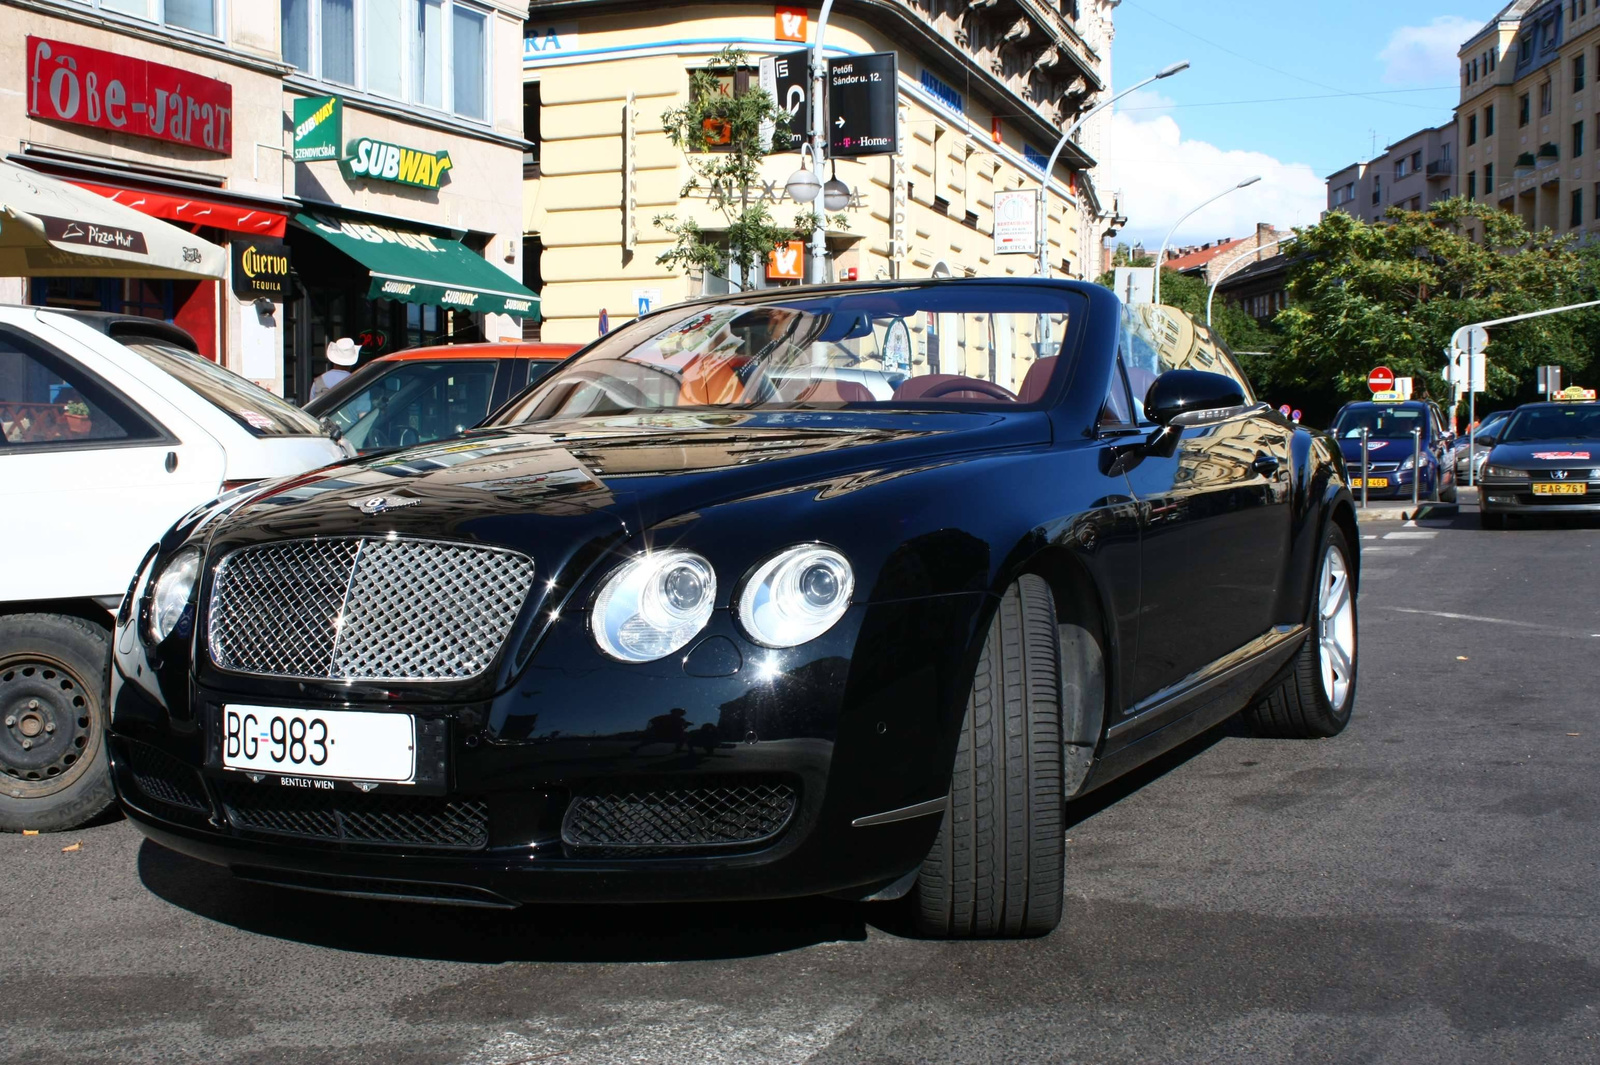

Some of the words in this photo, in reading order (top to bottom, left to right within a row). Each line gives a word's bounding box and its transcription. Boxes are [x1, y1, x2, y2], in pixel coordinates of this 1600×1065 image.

[833, 64, 853, 75] Petőfi
[833, 74, 859, 86] Sándor
[870, 73, 882, 83] 12.
[295, 97, 336, 142] SUBWAY
[860, 136, 888, 147] Home
[350, 139, 451, 188] SUBWAY
[88, 225, 115, 245] Pizza
[114, 231, 134, 248] Hut
[314, 213, 446, 253] SUBWAY
[242, 245, 287, 278] Cuervo
[252, 280, 281, 291] TEQUILA
[382, 280, 415, 296] SUBWAY
[441, 289, 478, 306] SUBWAY
[504, 298, 532, 312] SUBWAY
[280, 777, 312, 788] BENTLEY
[315, 780, 335, 790] WIEN
